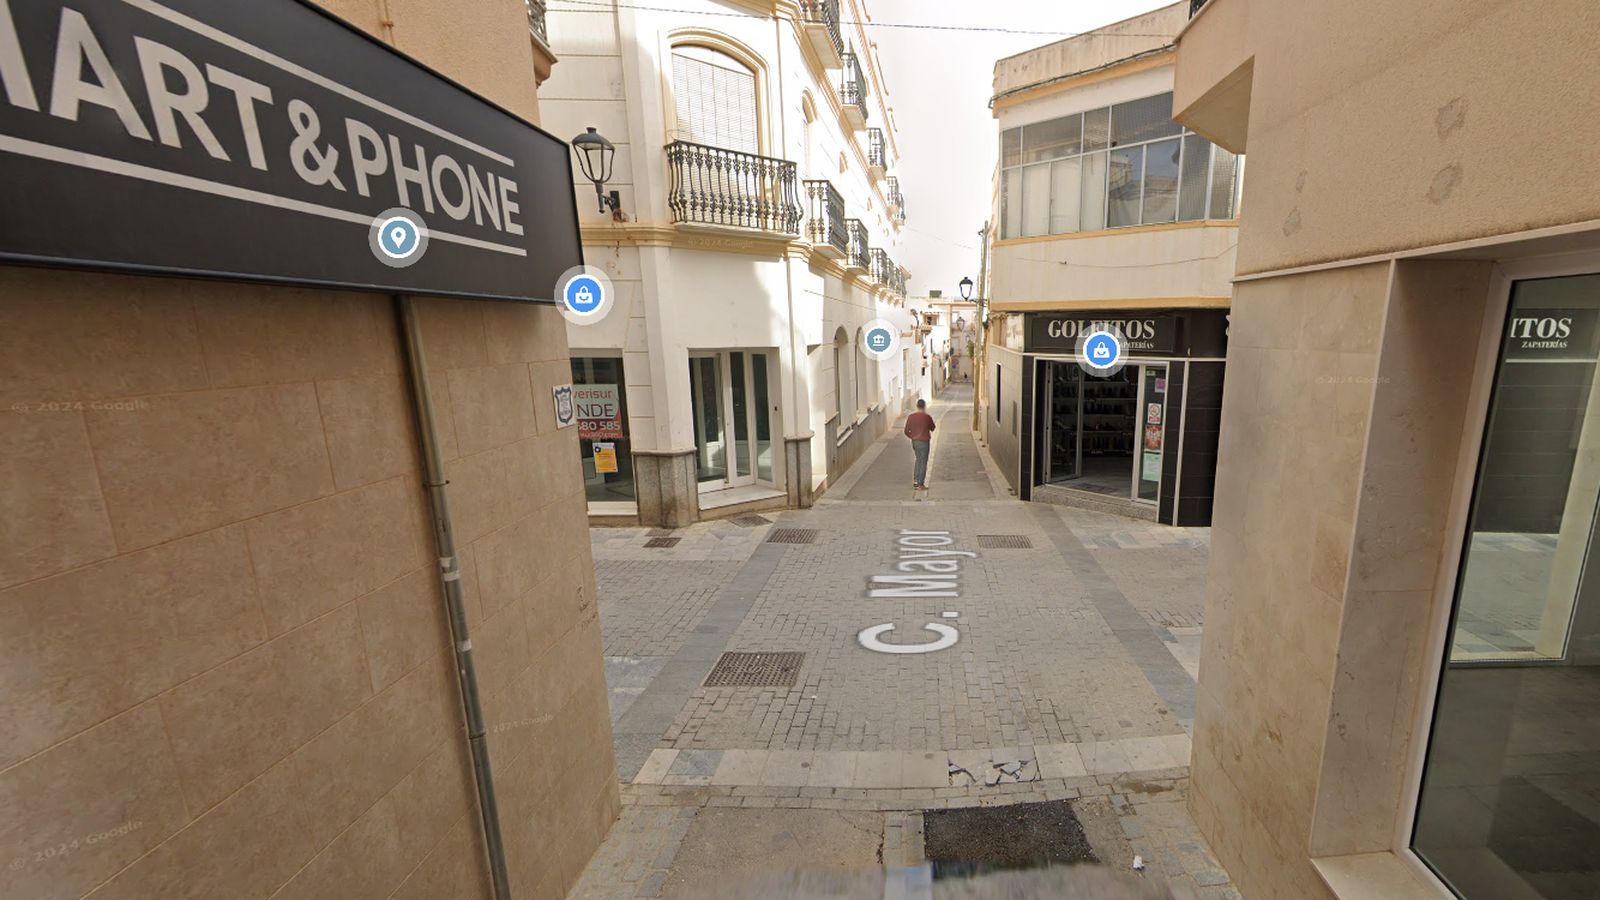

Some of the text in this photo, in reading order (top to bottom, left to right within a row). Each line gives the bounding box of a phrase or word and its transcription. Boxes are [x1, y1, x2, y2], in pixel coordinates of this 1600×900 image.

[1048, 320, 1155, 339] GOLFITOS
[1120, 340, 1154, 349] APATERÍAS
[1521, 339, 1568, 348] ZAPATERÍAS
[599, 420, 621, 431] 585
